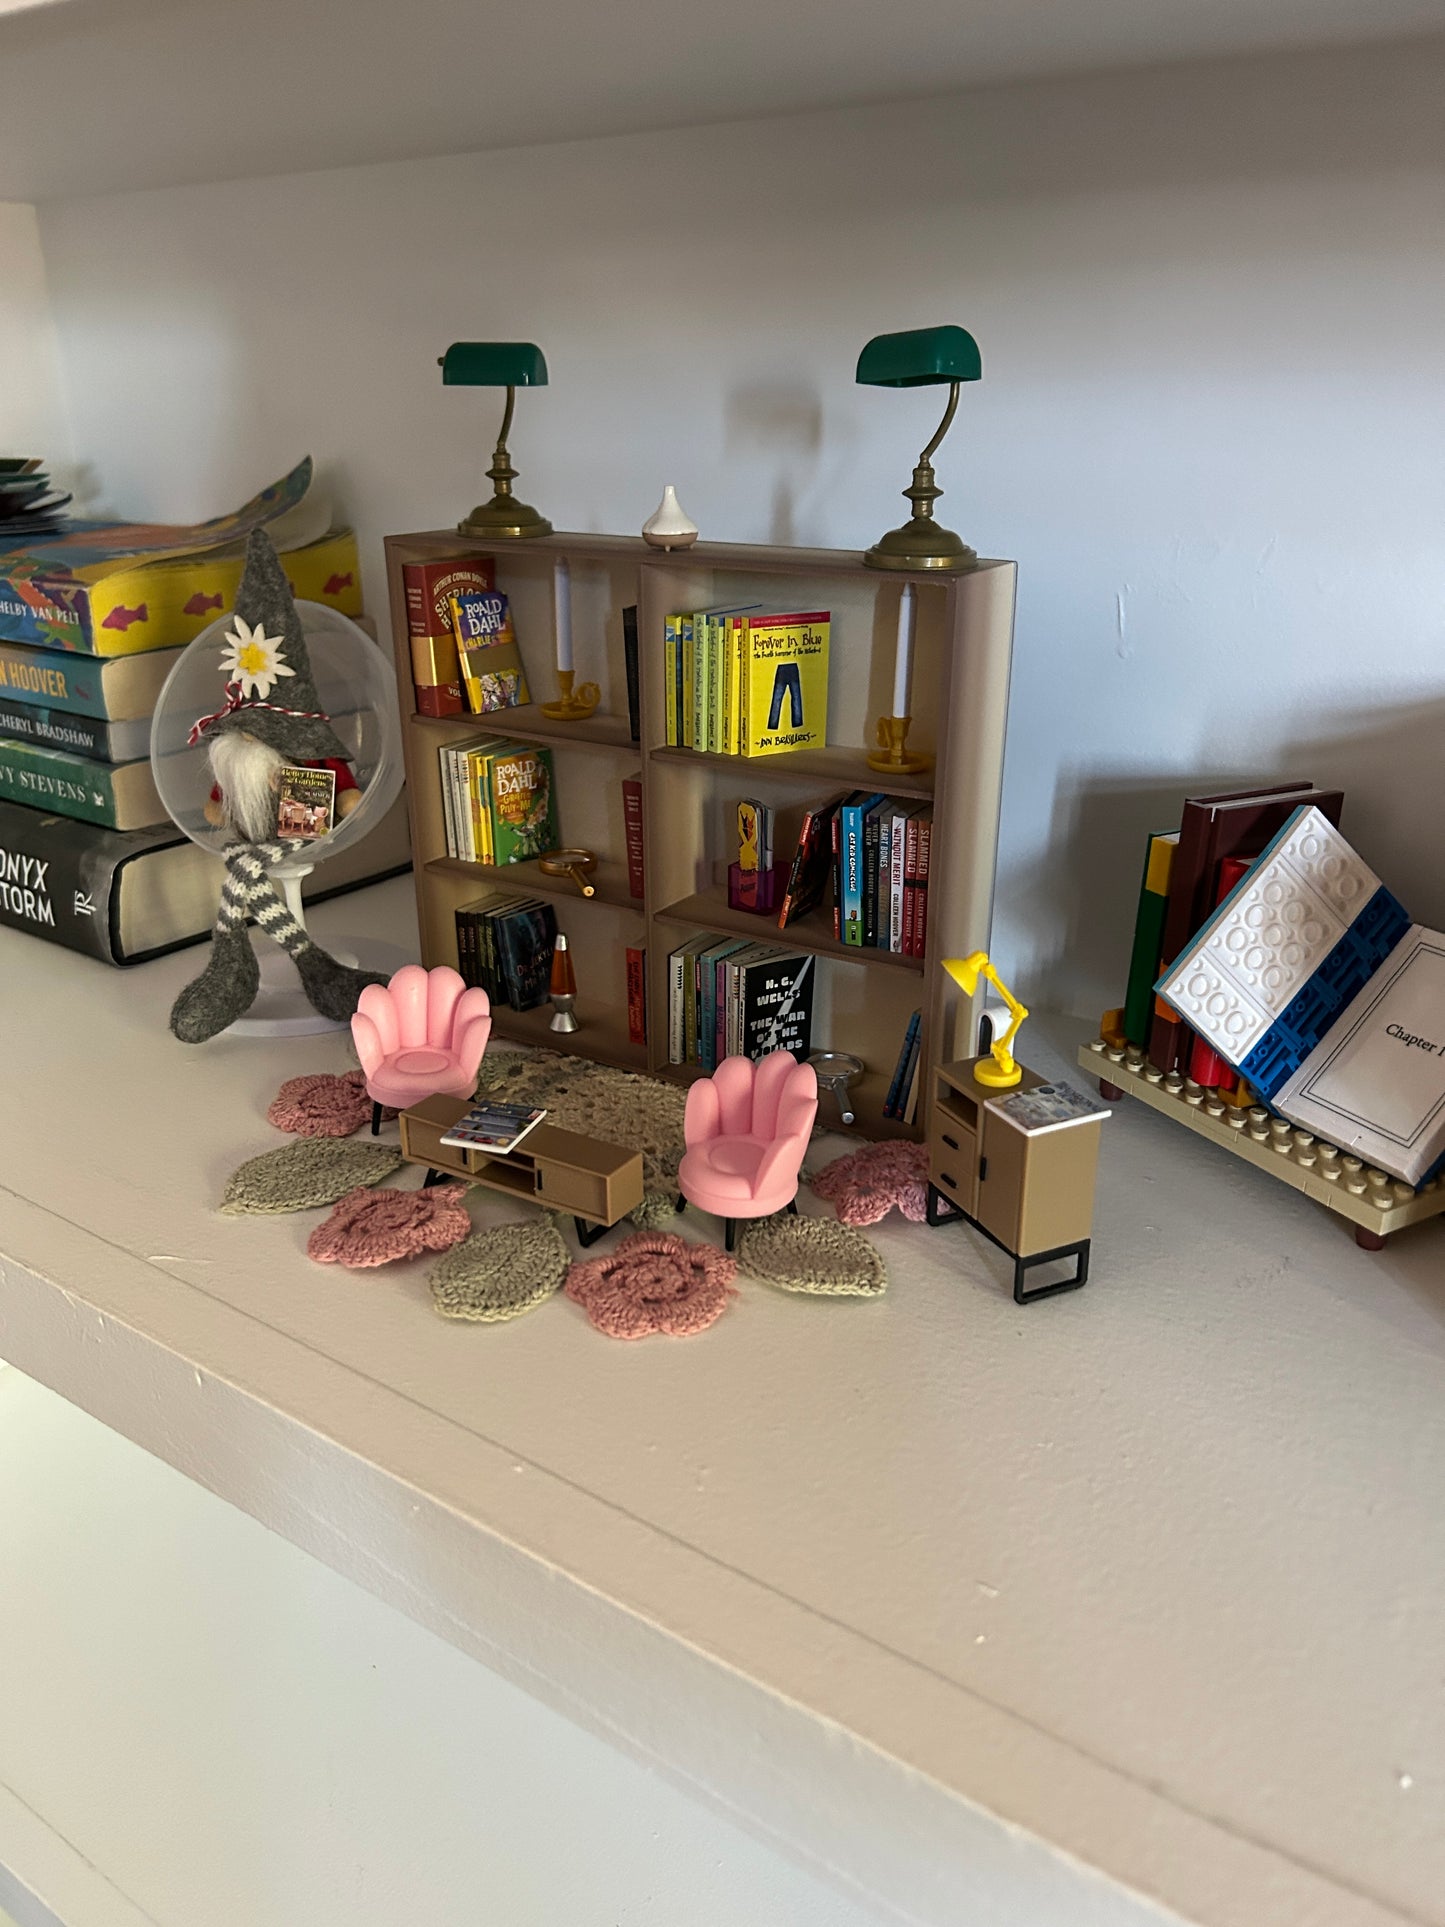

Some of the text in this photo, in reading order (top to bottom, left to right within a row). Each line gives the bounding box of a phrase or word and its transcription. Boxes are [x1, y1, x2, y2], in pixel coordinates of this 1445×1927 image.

[452, 571, 471, 583] CONAN
[0, 600, 80, 625] HELBY VAN PELT
[465, 599, 502, 619] ROALD
[469, 614, 506, 636] DAHL
[465, 635, 491, 650] CHARLIE
[753, 633, 784, 651] Forever
[802, 628, 822, 646] Blue
[9, 662, 68, 699] HOOVER
[36, 721, 95, 749] BRADSHAW
[495, 760, 536, 780] ROALD
[20, 770, 87, 804] STEVENS
[497, 774, 538, 796] DAHL
[848, 832, 856, 845] CAT
[871, 823, 879, 843] NEVER
[880, 823, 889, 868] HEART BONES
[892, 828, 902, 886] WITHOUT MERIT
[907, 828, 918, 873] SLAMMED
[918, 829, 930, 875] SLAMMED
[0, 881, 56, 927] TORM
[905, 892, 914, 937] COLLEEN HOOVER
[916, 893, 925, 939] COLLEEN HOOVER
[756, 989, 801, 1007] WELLS
[750, 1011, 806, 1031] THE WAR
[774, 1025, 798, 1039] THE
[1386, 1023, 1438, 1053] Chapter
